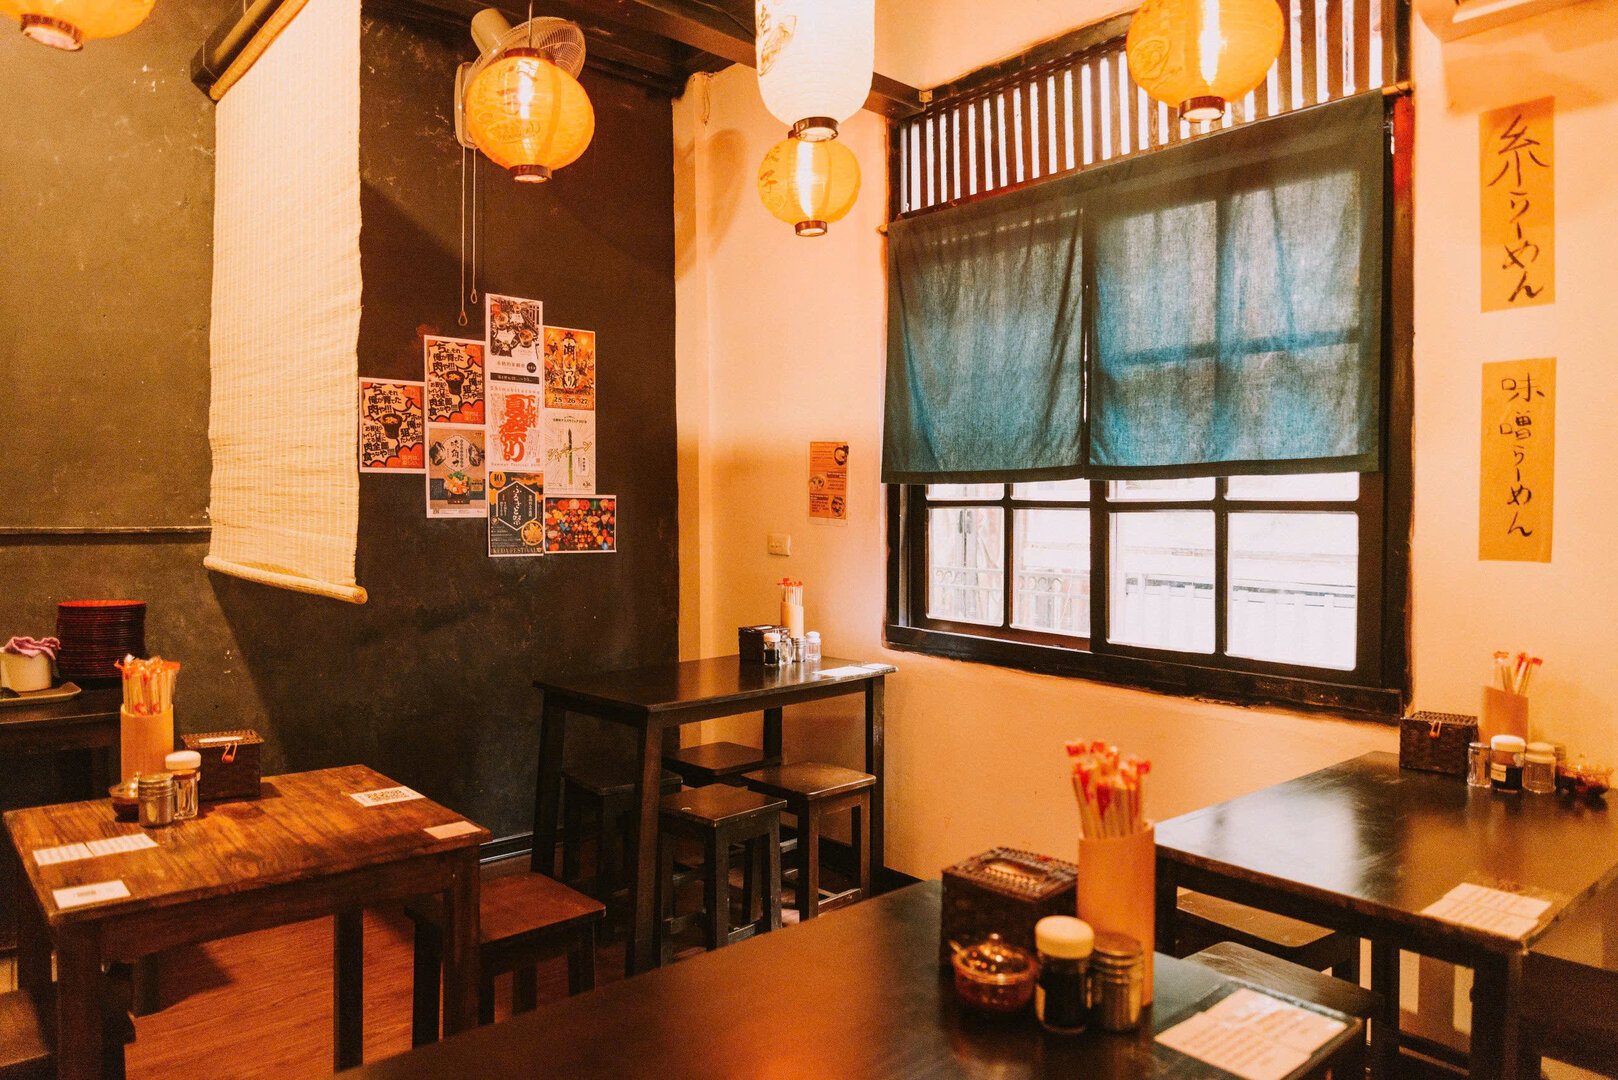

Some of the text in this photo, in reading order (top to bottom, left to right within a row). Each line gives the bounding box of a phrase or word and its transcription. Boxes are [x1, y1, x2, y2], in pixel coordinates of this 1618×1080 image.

[1499, 372, 1545, 537] 味噌らーめん
